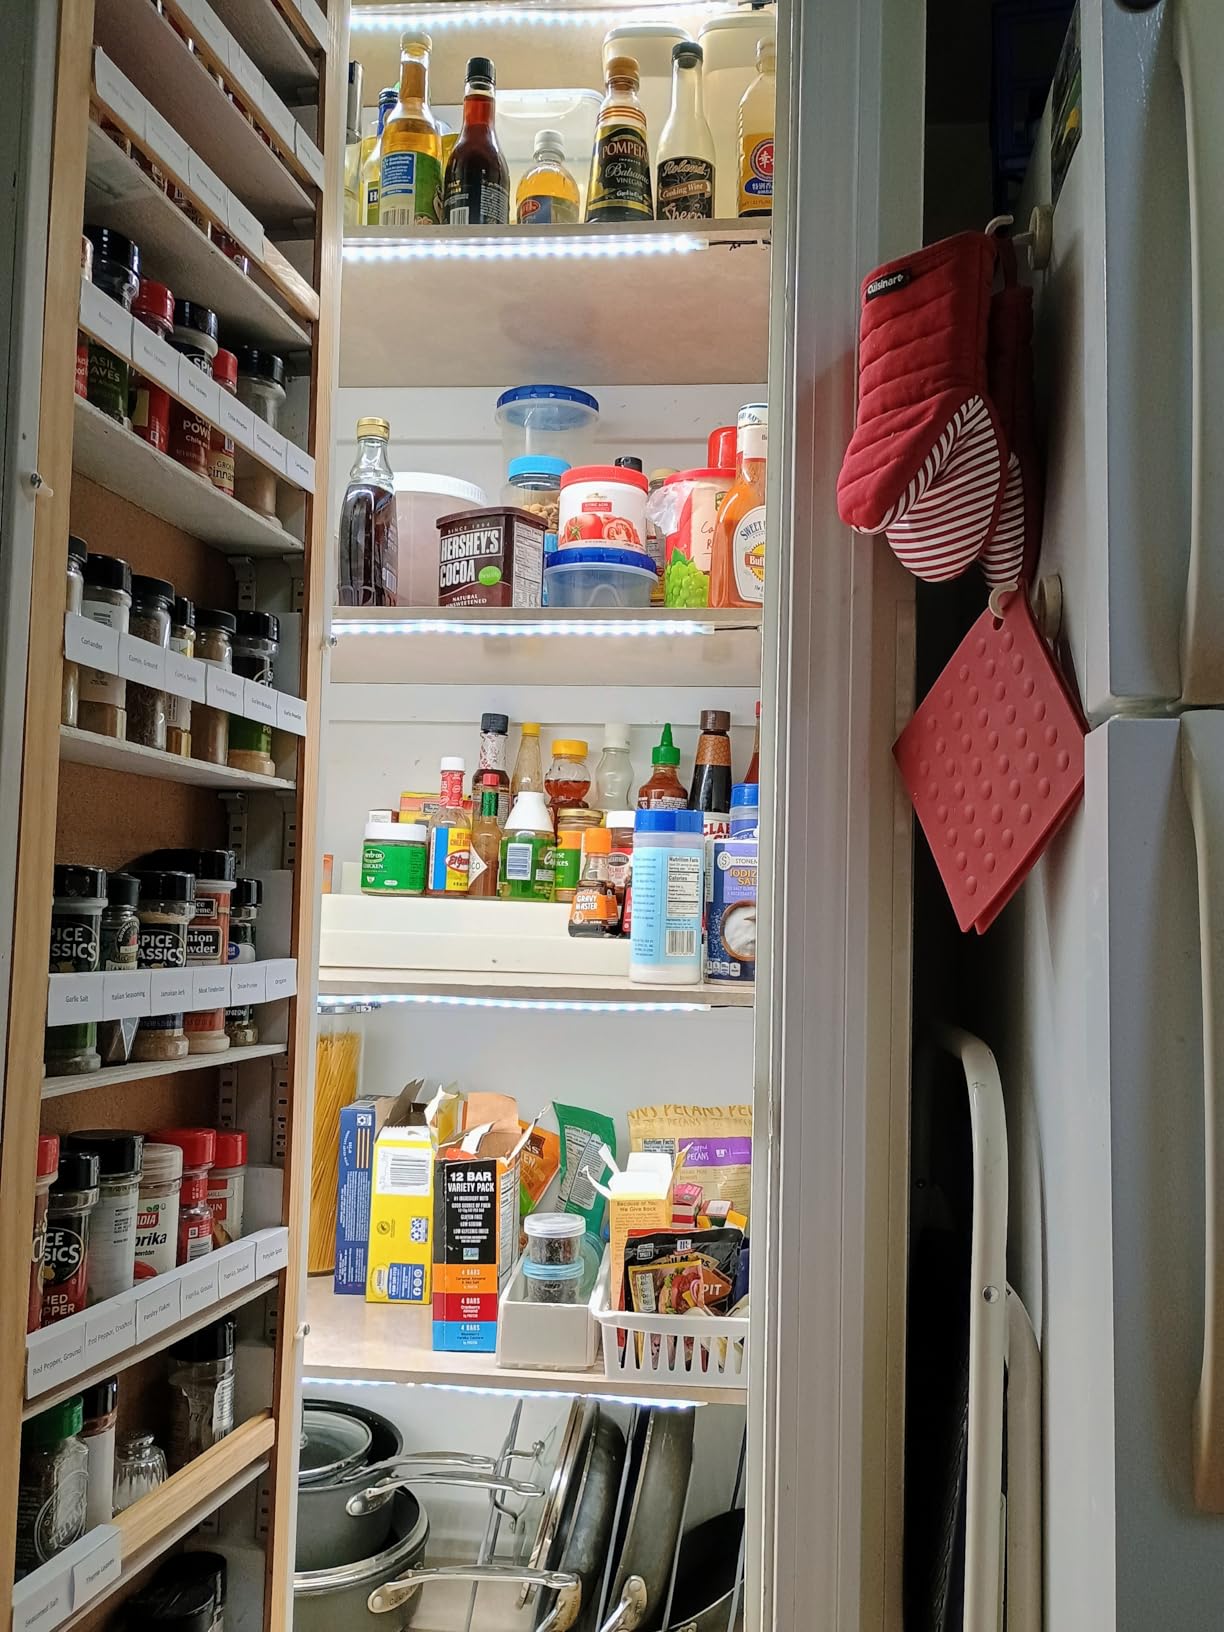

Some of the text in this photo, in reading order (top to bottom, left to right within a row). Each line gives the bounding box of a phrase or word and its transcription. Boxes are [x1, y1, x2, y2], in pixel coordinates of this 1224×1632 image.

[662, 182, 704, 199] Cooking Wine
[90, 355, 117, 371] ASIL
[90, 366, 121, 383] AVES
[740, 520, 761, 541] SWEET
[441, 529, 499, 562] HERSHEY'S
[440, 559, 475, 588] COCOA
[452, 593, 478, 602] NATURAL
[81, 636, 103, 650] Coriander
[576, 903, 597, 911] MASTER
[52, 942, 97, 962] SSICS
[65, 995, 89, 1003] Garlic Salt
[111, 990, 146, 1001] Italian Seasoning
[160, 990, 178, 998] Jamaican
[663, 1104, 723, 1118] PECANS
[686, 1153, 709, 1161] PECANS
[450, 1172, 492, 1182] 12 BAR
[447, 1183, 495, 1193] VARIETY PACK
[143, 1302, 170, 1321] Parsley Flakes
[32, 1345, 82, 1376] Red Pepper, Ground
